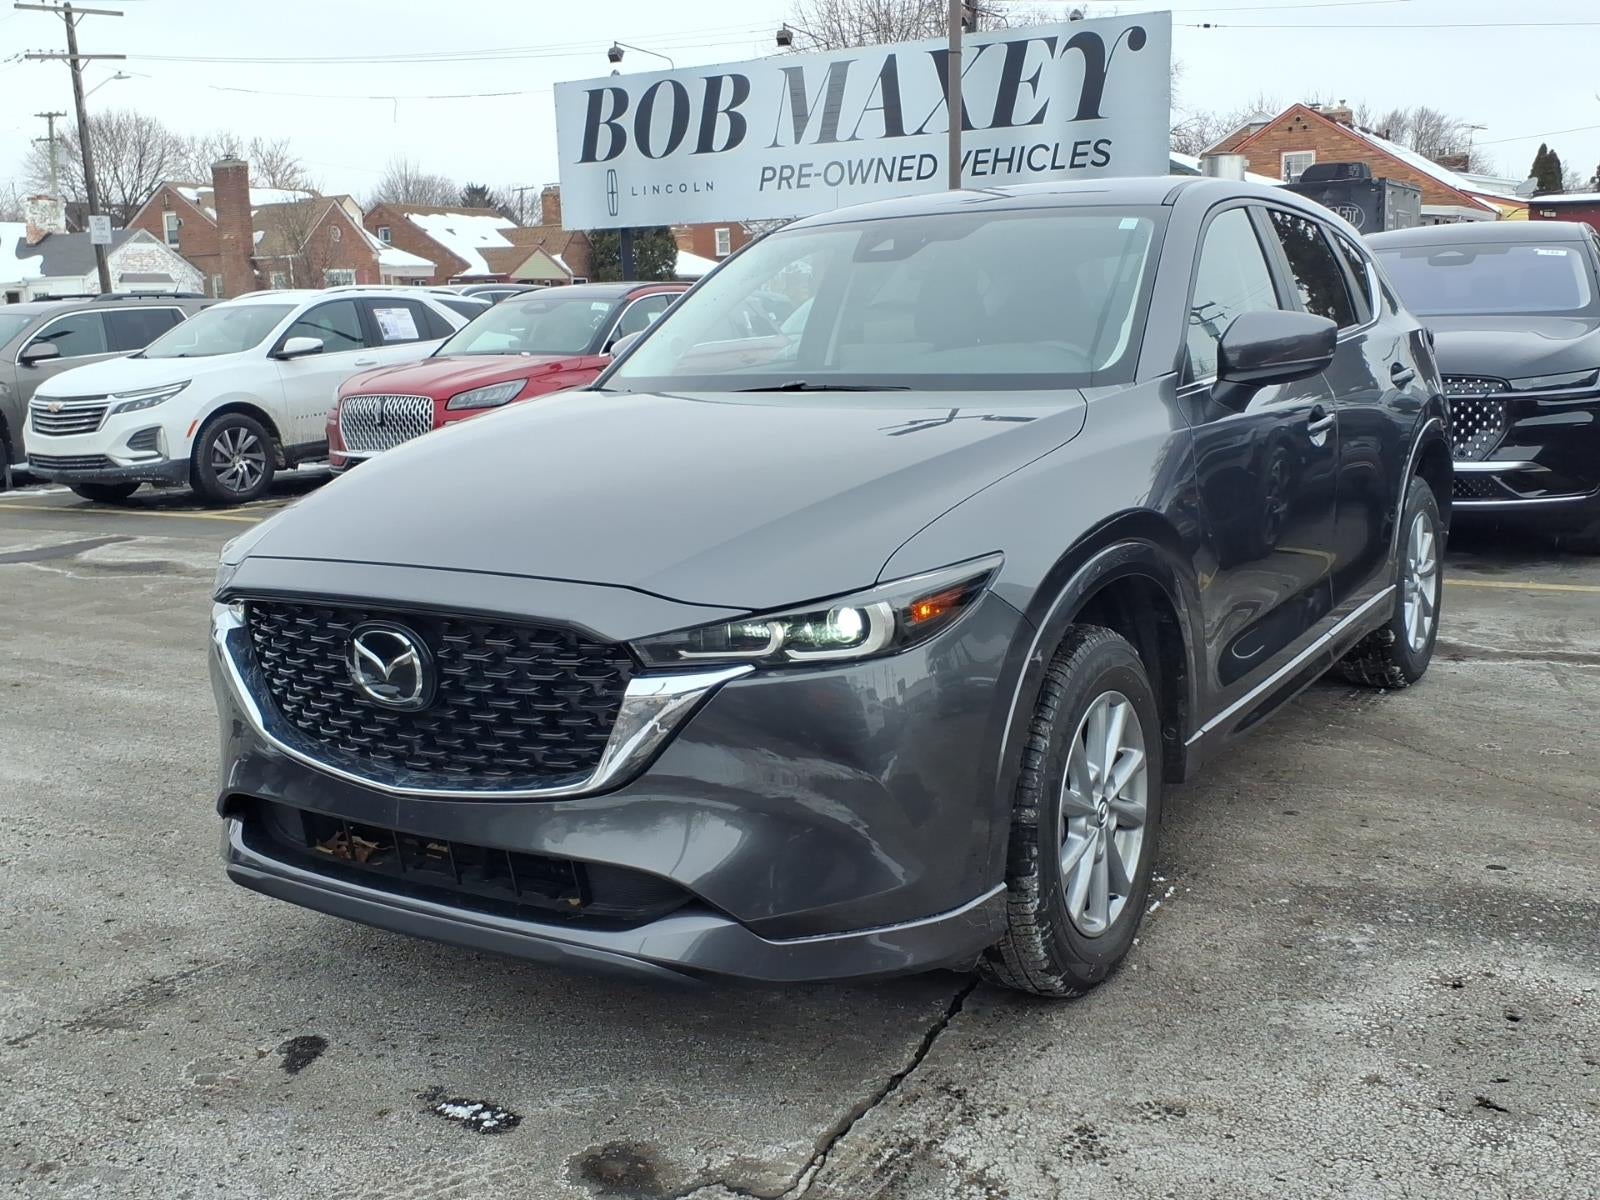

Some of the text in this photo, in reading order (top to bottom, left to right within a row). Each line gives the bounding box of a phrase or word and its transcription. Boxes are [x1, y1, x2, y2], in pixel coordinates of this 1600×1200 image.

[574, 26, 1147, 164] BOB MAXEY
[631, 181, 714, 196] LINCOLN
[759, 153, 938, 191] PRE-OWNED
